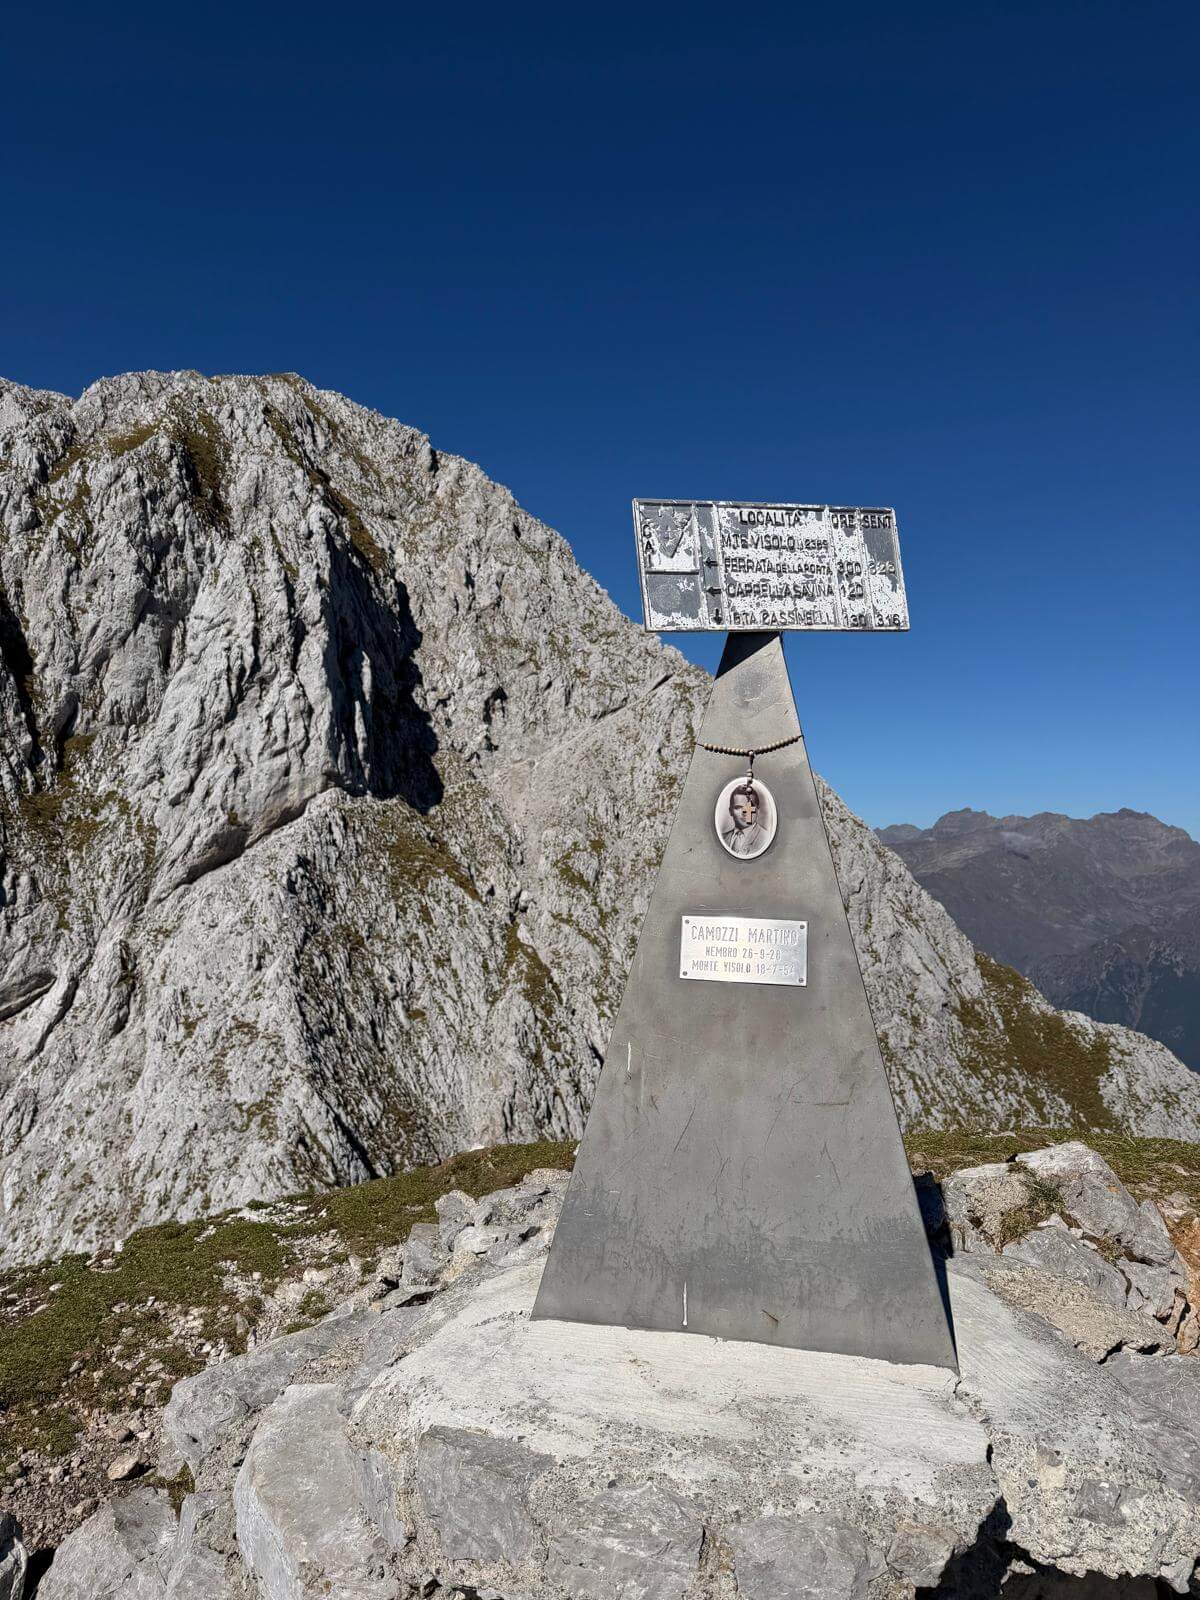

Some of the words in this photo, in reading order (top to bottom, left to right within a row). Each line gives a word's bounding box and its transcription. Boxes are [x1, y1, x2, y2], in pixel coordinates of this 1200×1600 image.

[831, 514, 855, 529] ORE
[750, 534, 796, 552] VISOLO
[724, 558, 773, 574] FERRATA
[691, 925, 738, 942] CAMOZZI
[748, 927, 798, 945] MARTINO
[705, 946, 738, 958] NEMBRO
[691, 959, 719, 972] MONTE
[723, 961, 751, 974] VISOLO
